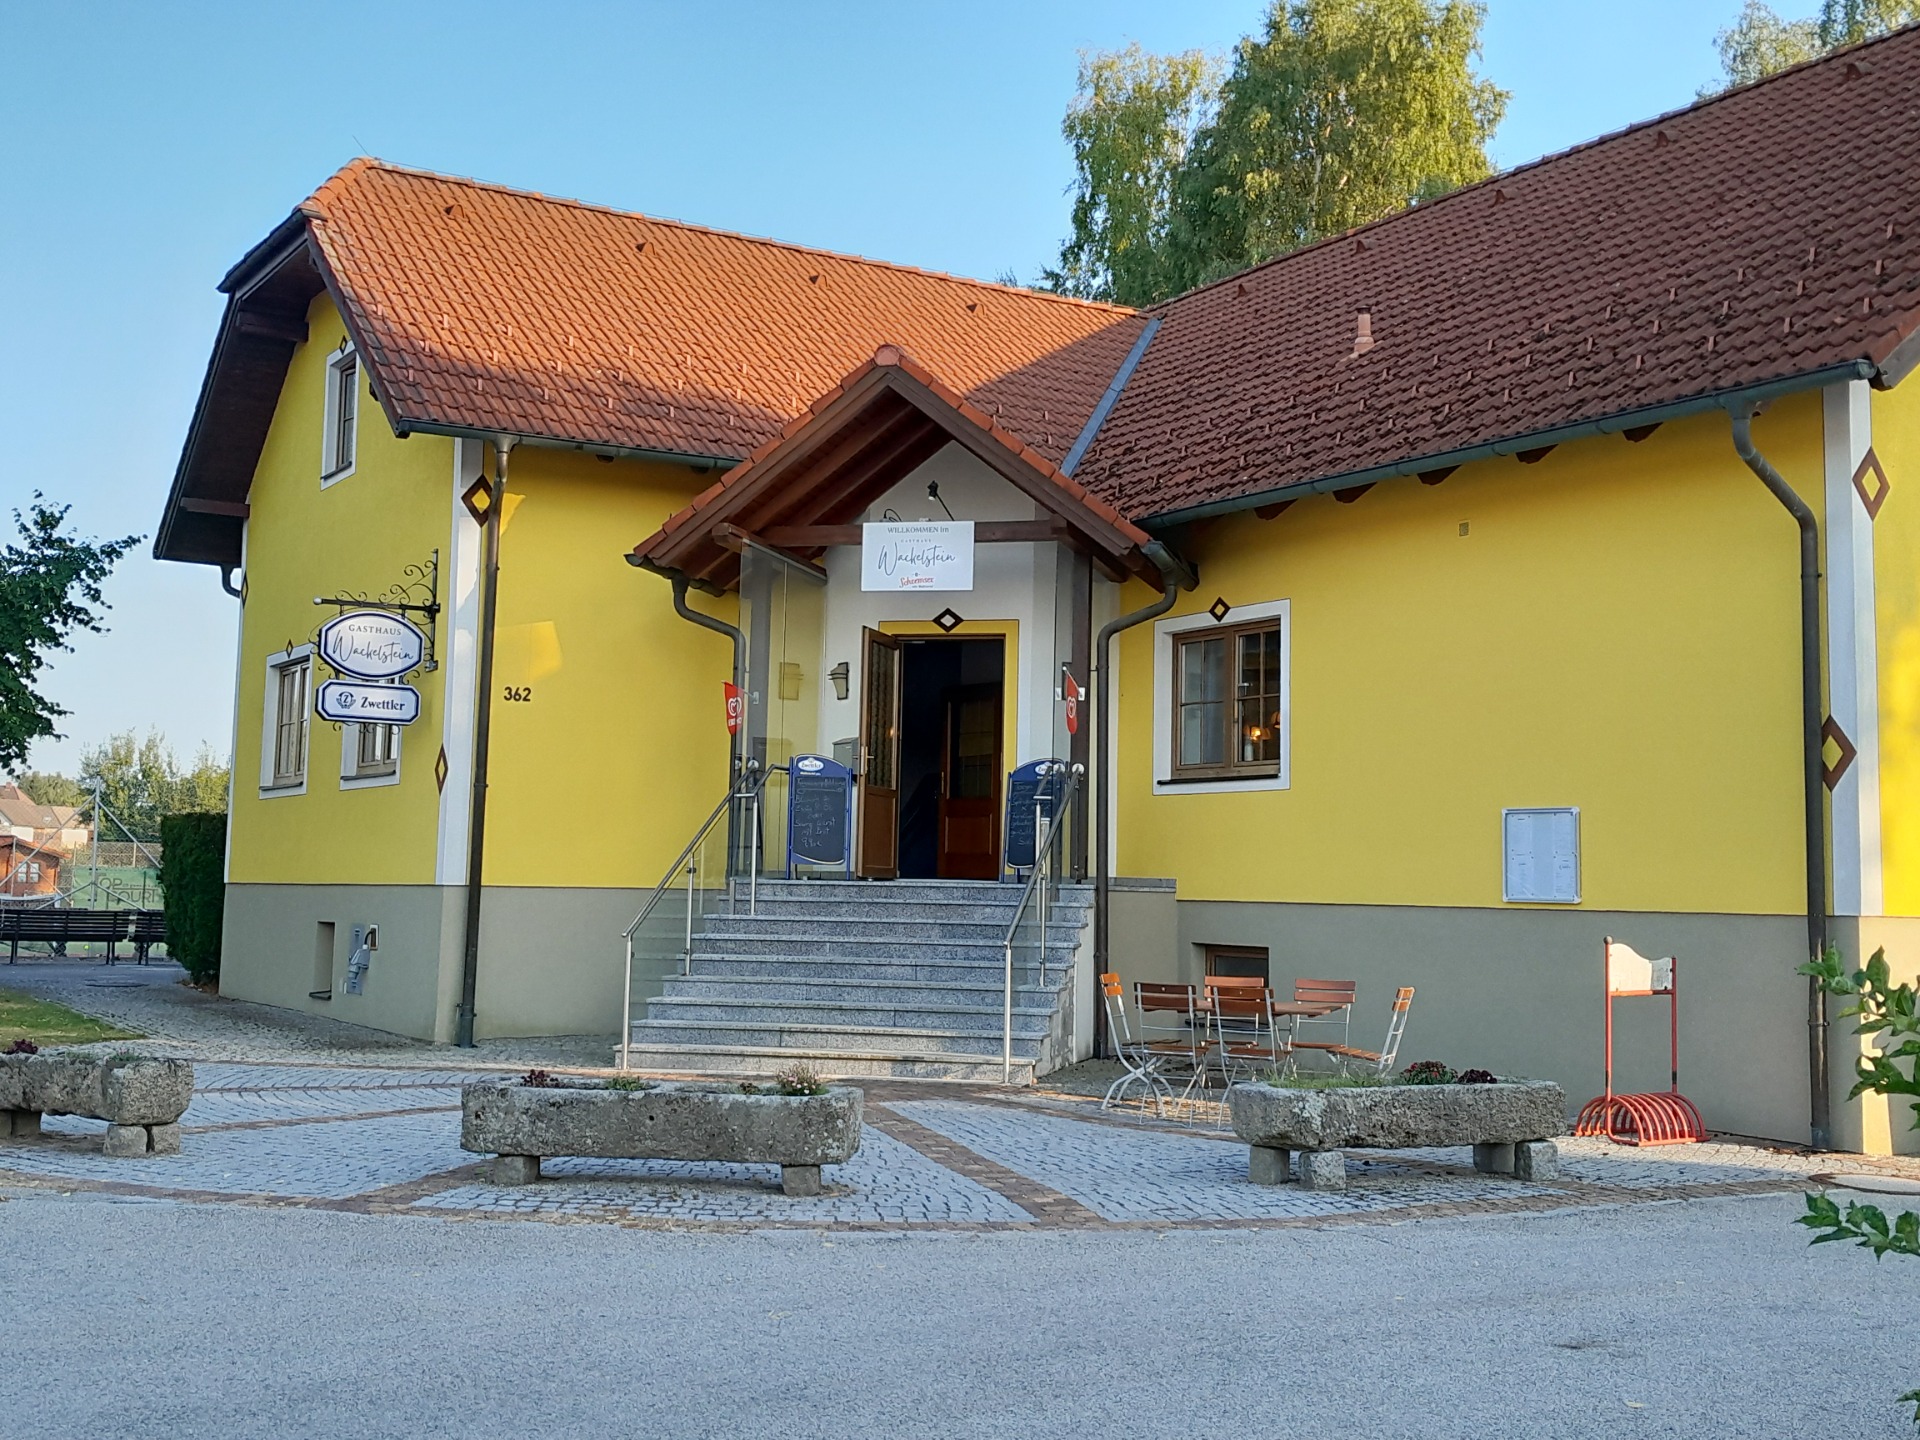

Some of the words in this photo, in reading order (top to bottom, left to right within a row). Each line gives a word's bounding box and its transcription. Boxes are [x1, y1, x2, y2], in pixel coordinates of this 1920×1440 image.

[878, 541, 956, 576] Wackelstein
[348, 623, 402, 636] GASTHAUS
[332, 629, 414, 664] Wackelstein
[503, 686, 532, 702] 362
[360, 696, 406, 711] Zwettler
